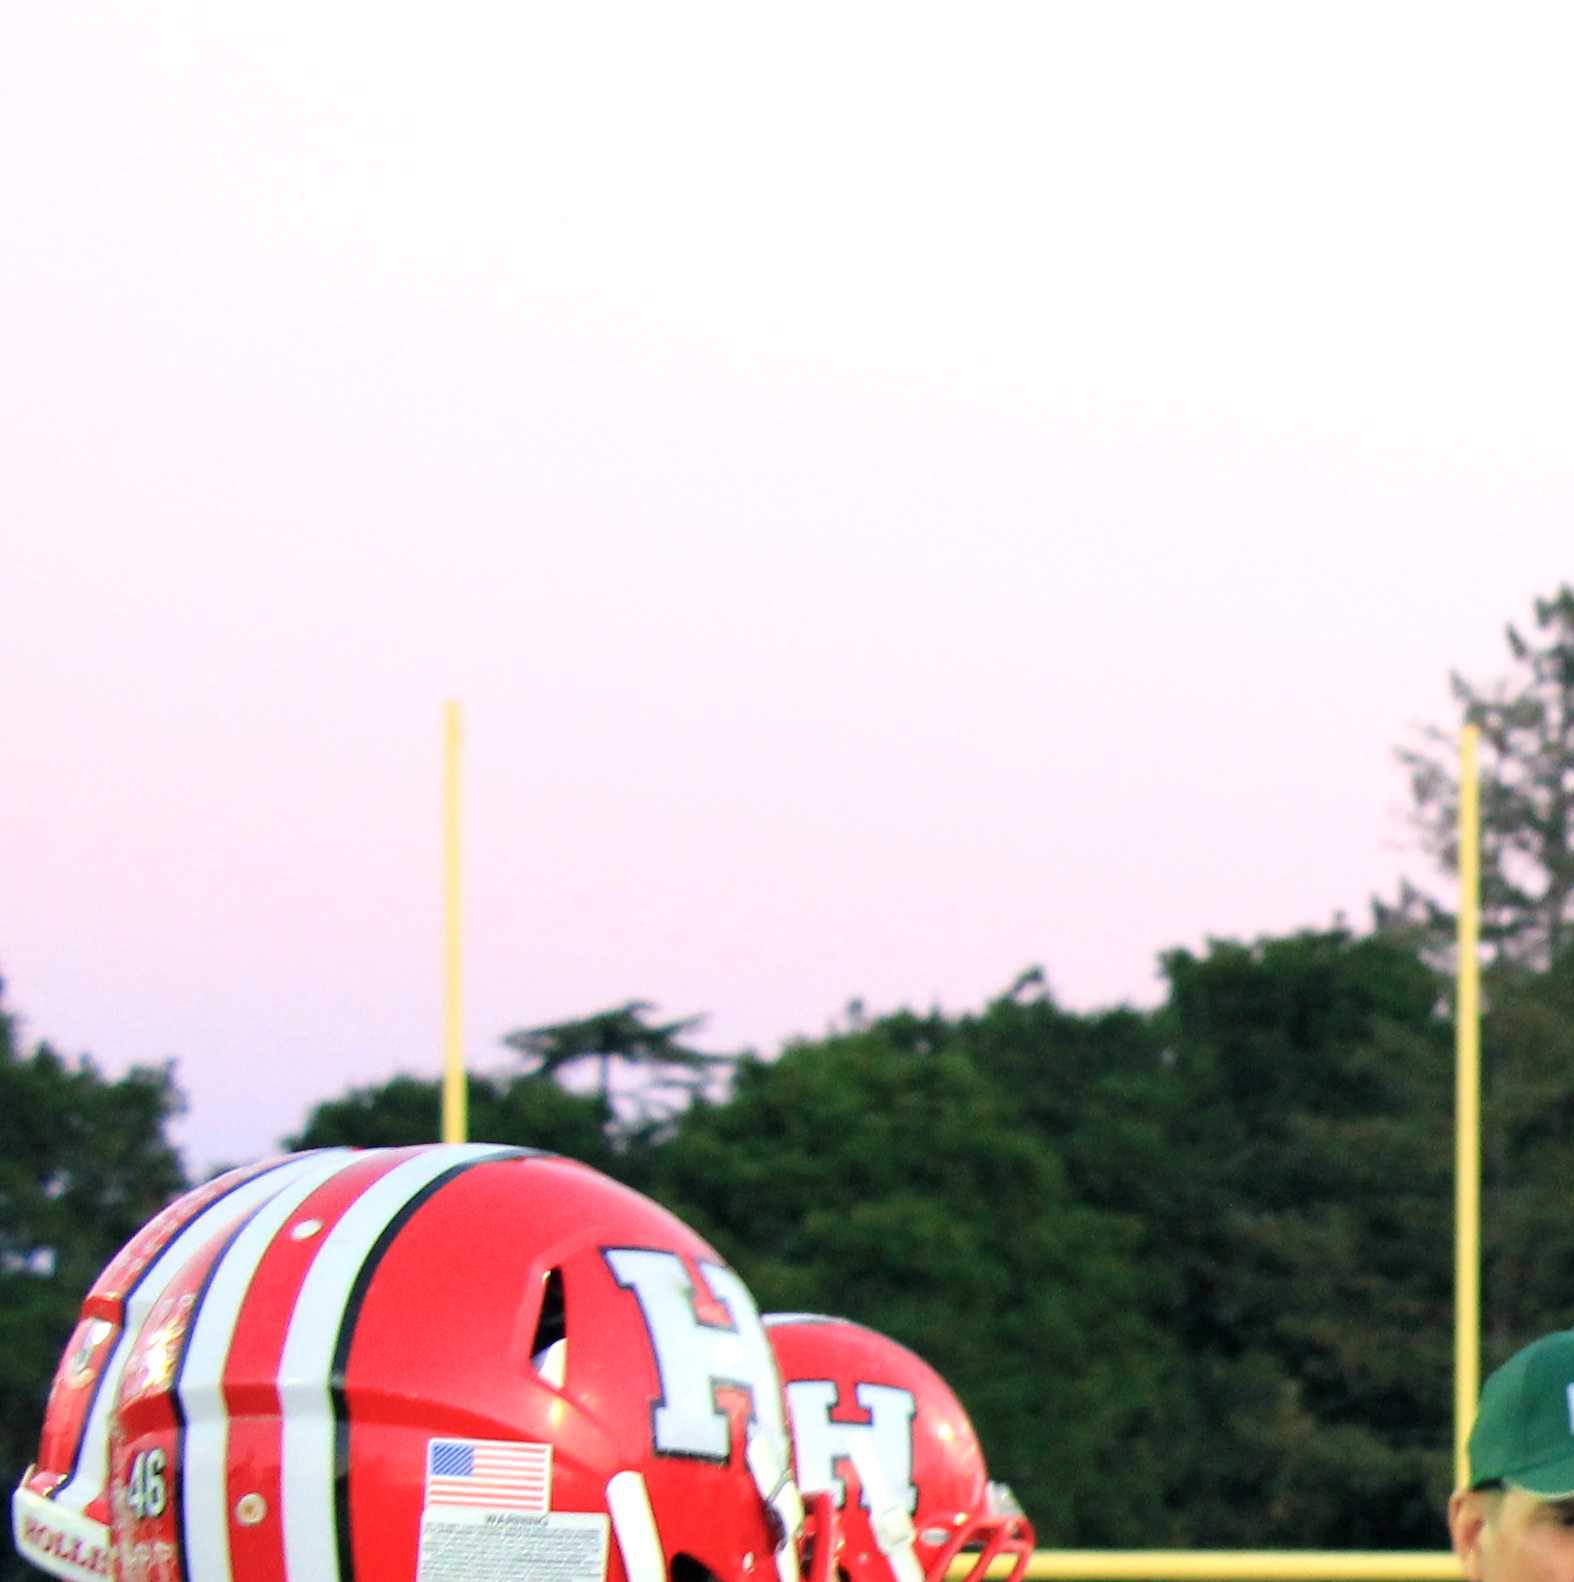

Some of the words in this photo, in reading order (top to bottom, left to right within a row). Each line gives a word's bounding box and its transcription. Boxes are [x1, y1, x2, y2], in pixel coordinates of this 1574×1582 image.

[597, 1247, 790, 1466] H
[126, 1447, 169, 1520] 46
[785, 1379, 917, 1518] H
